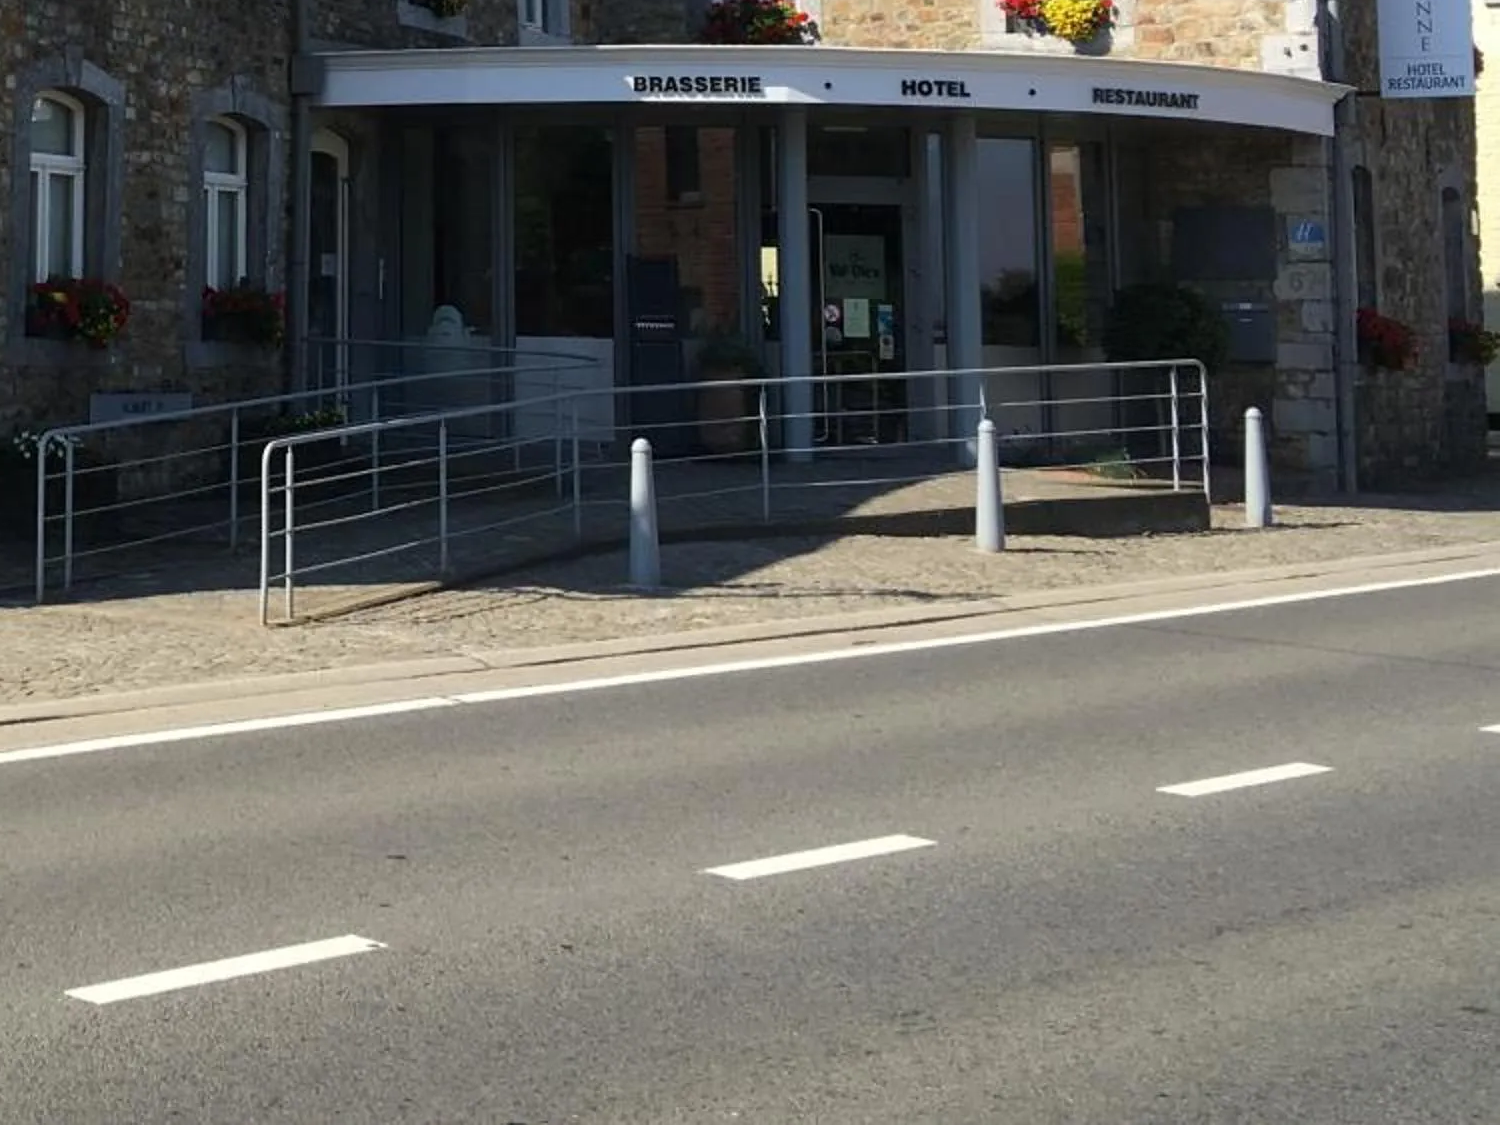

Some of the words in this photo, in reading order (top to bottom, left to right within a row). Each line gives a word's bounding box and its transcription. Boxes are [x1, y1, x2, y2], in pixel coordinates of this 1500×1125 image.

[1407, 62, 1446, 77] HOTEL
[632, 75, 763, 94] BRASSERIE
[900, 79, 971, 98] HOTEL
[1388, 76, 1466, 91] RESTAURANT
[1092, 87, 1201, 109] RESTAURANT
